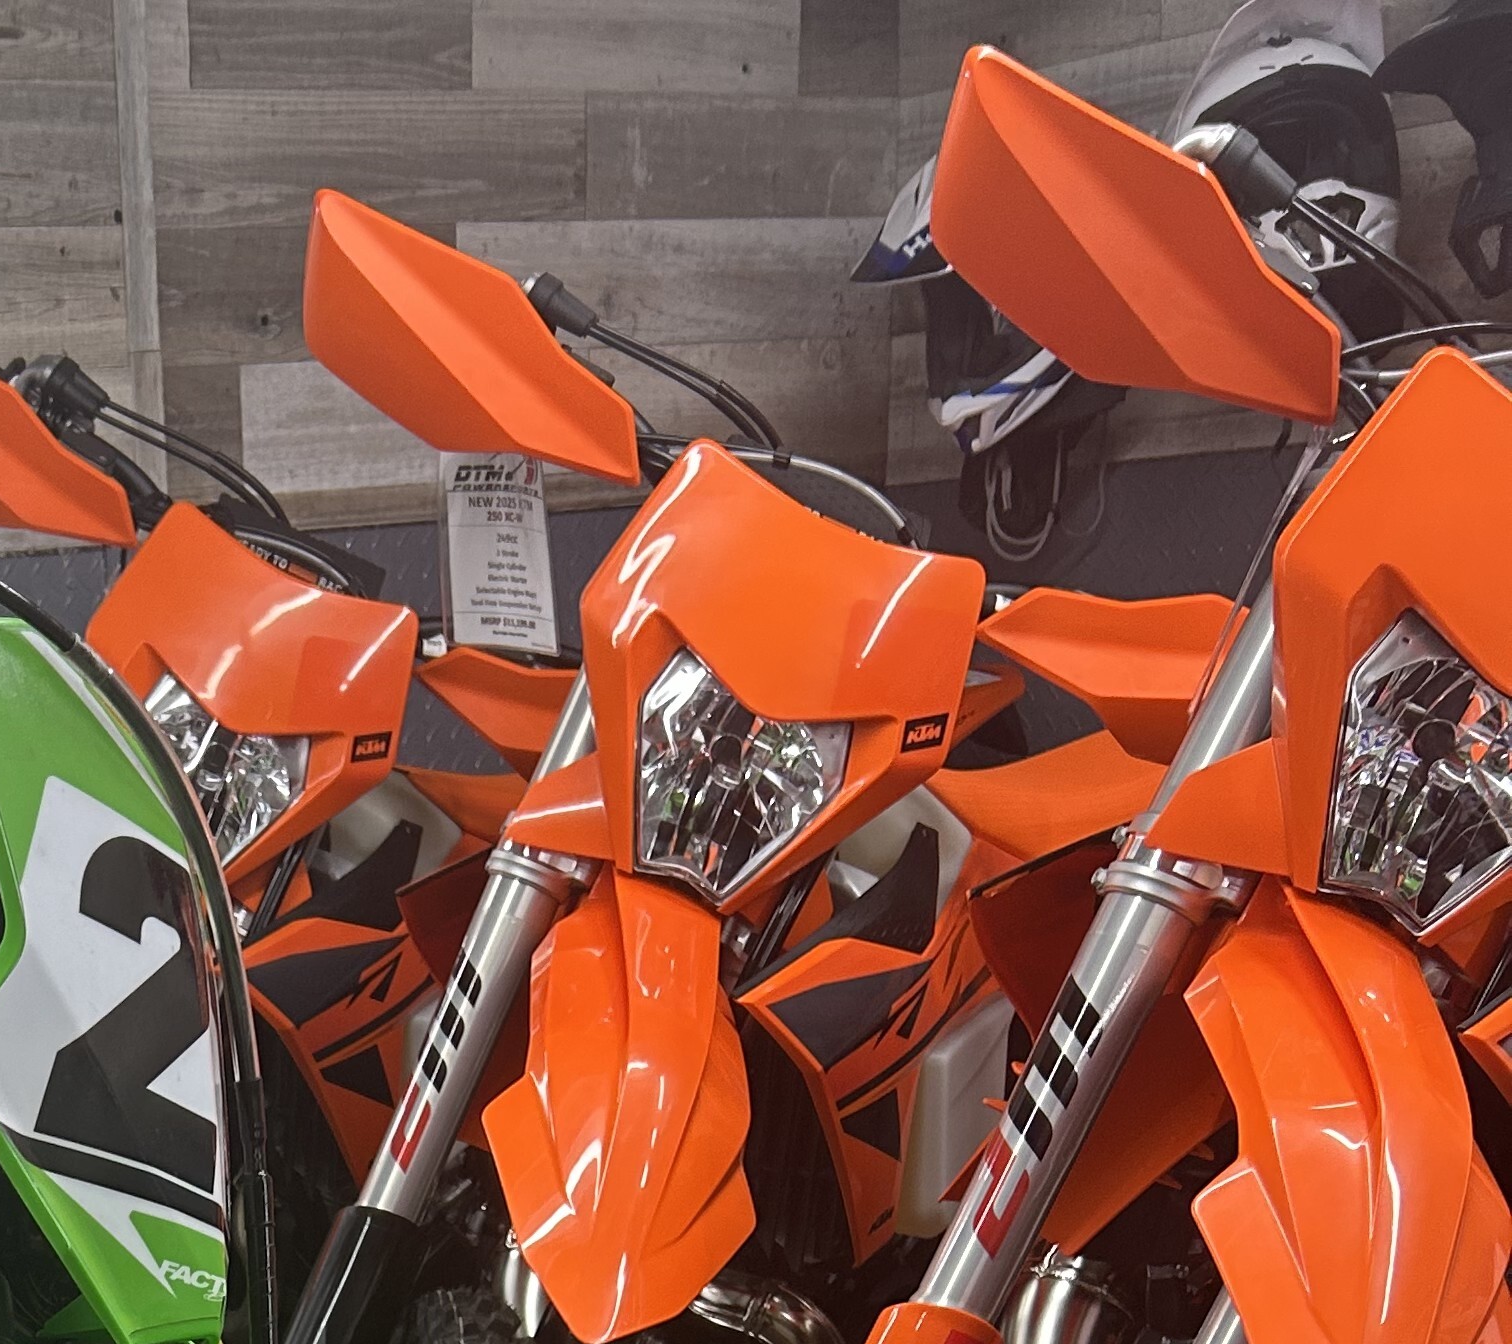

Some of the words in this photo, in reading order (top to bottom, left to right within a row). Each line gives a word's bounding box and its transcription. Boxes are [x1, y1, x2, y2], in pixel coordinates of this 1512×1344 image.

[468, 496, 494, 508] NEW
[272, 554, 288, 569] TO
[906, 723, 942, 745] KTM
[34, 835, 217, 1196] 2
[155, 1259, 227, 1298] FACT
